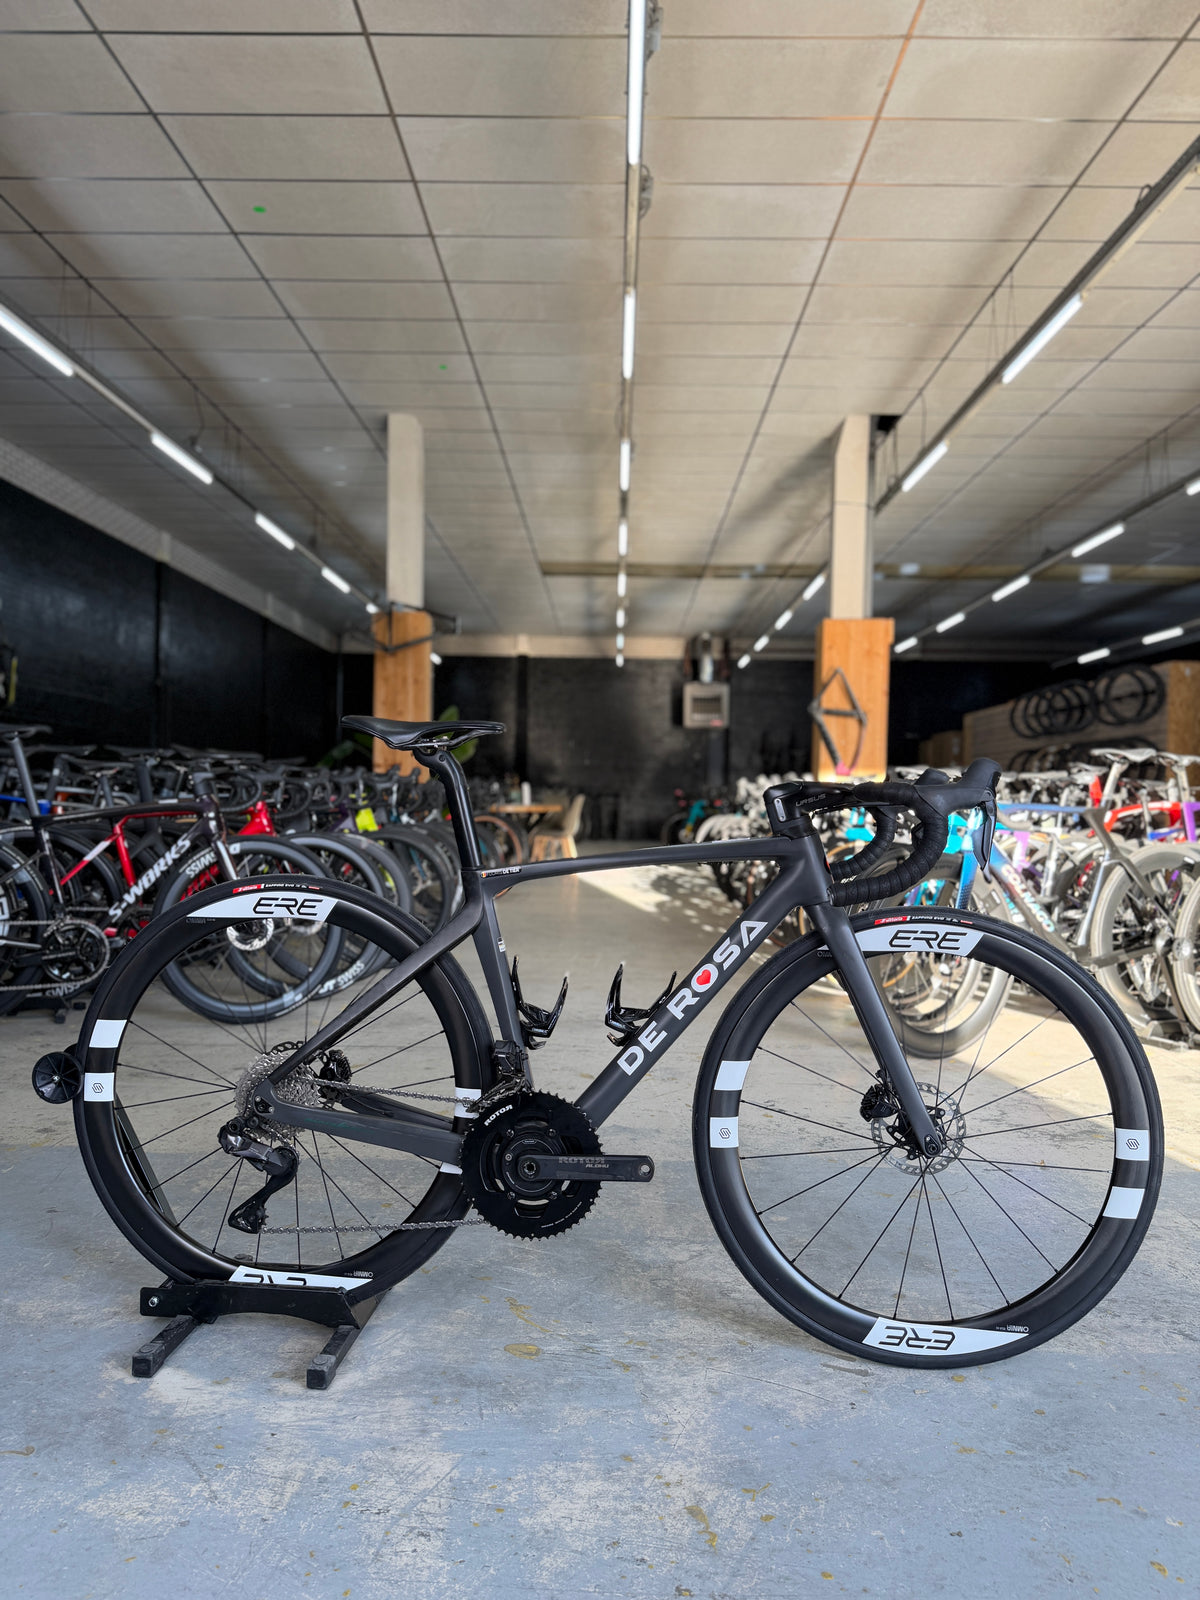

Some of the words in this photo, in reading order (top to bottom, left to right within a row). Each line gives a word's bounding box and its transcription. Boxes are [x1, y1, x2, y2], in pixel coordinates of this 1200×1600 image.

[796, 794, 826, 806] URSUS
[108, 839, 191, 922] S-WORKS
[252, 896, 324, 916] ERE
[1001, 863, 1055, 932] COLNAGO
[888, 929, 968, 950] ERE
[616, 1020, 668, 1076] DE
[666, 920, 768, 1020] ROSA
[484, 1104, 513, 1127] ROTOR
[558, 1156, 605, 1164] ROTOR
[878, 1325, 956, 1351] ERE
